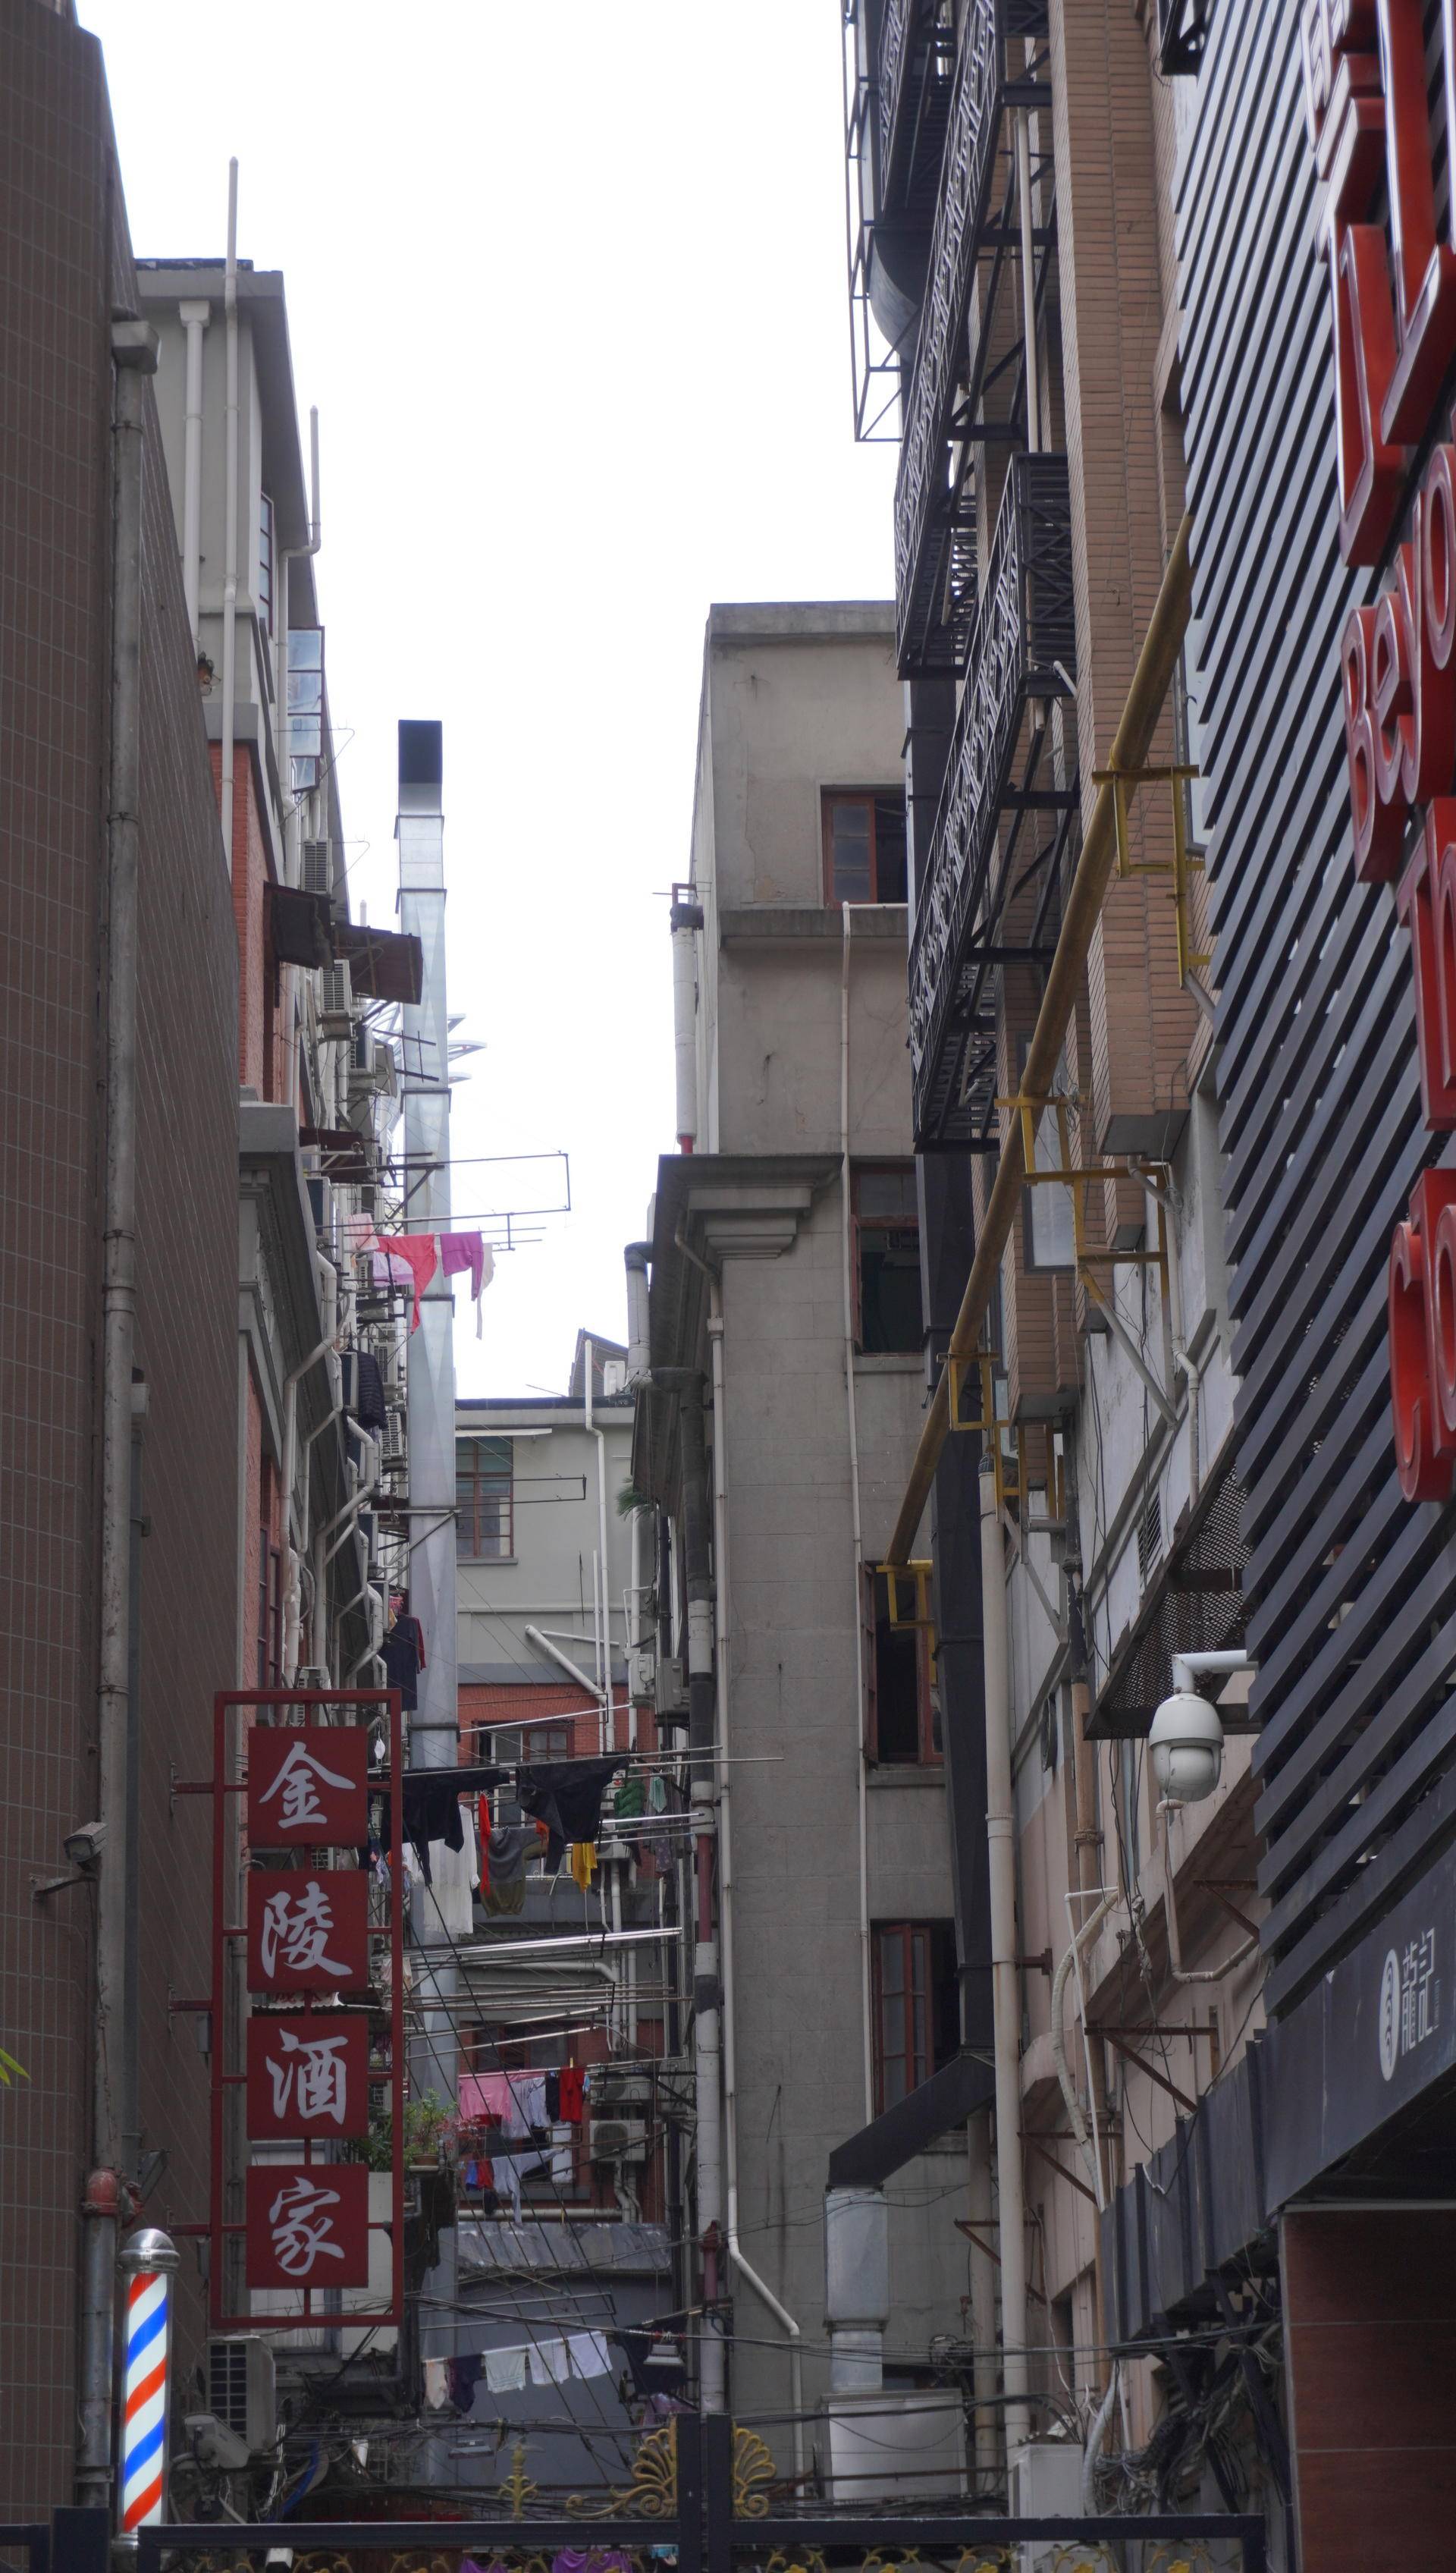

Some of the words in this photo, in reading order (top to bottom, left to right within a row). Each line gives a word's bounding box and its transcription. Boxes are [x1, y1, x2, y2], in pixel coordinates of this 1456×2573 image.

[1340, 402, 1456, 884] Beyo
[259, 1741, 356, 2276] 金陵酒家
